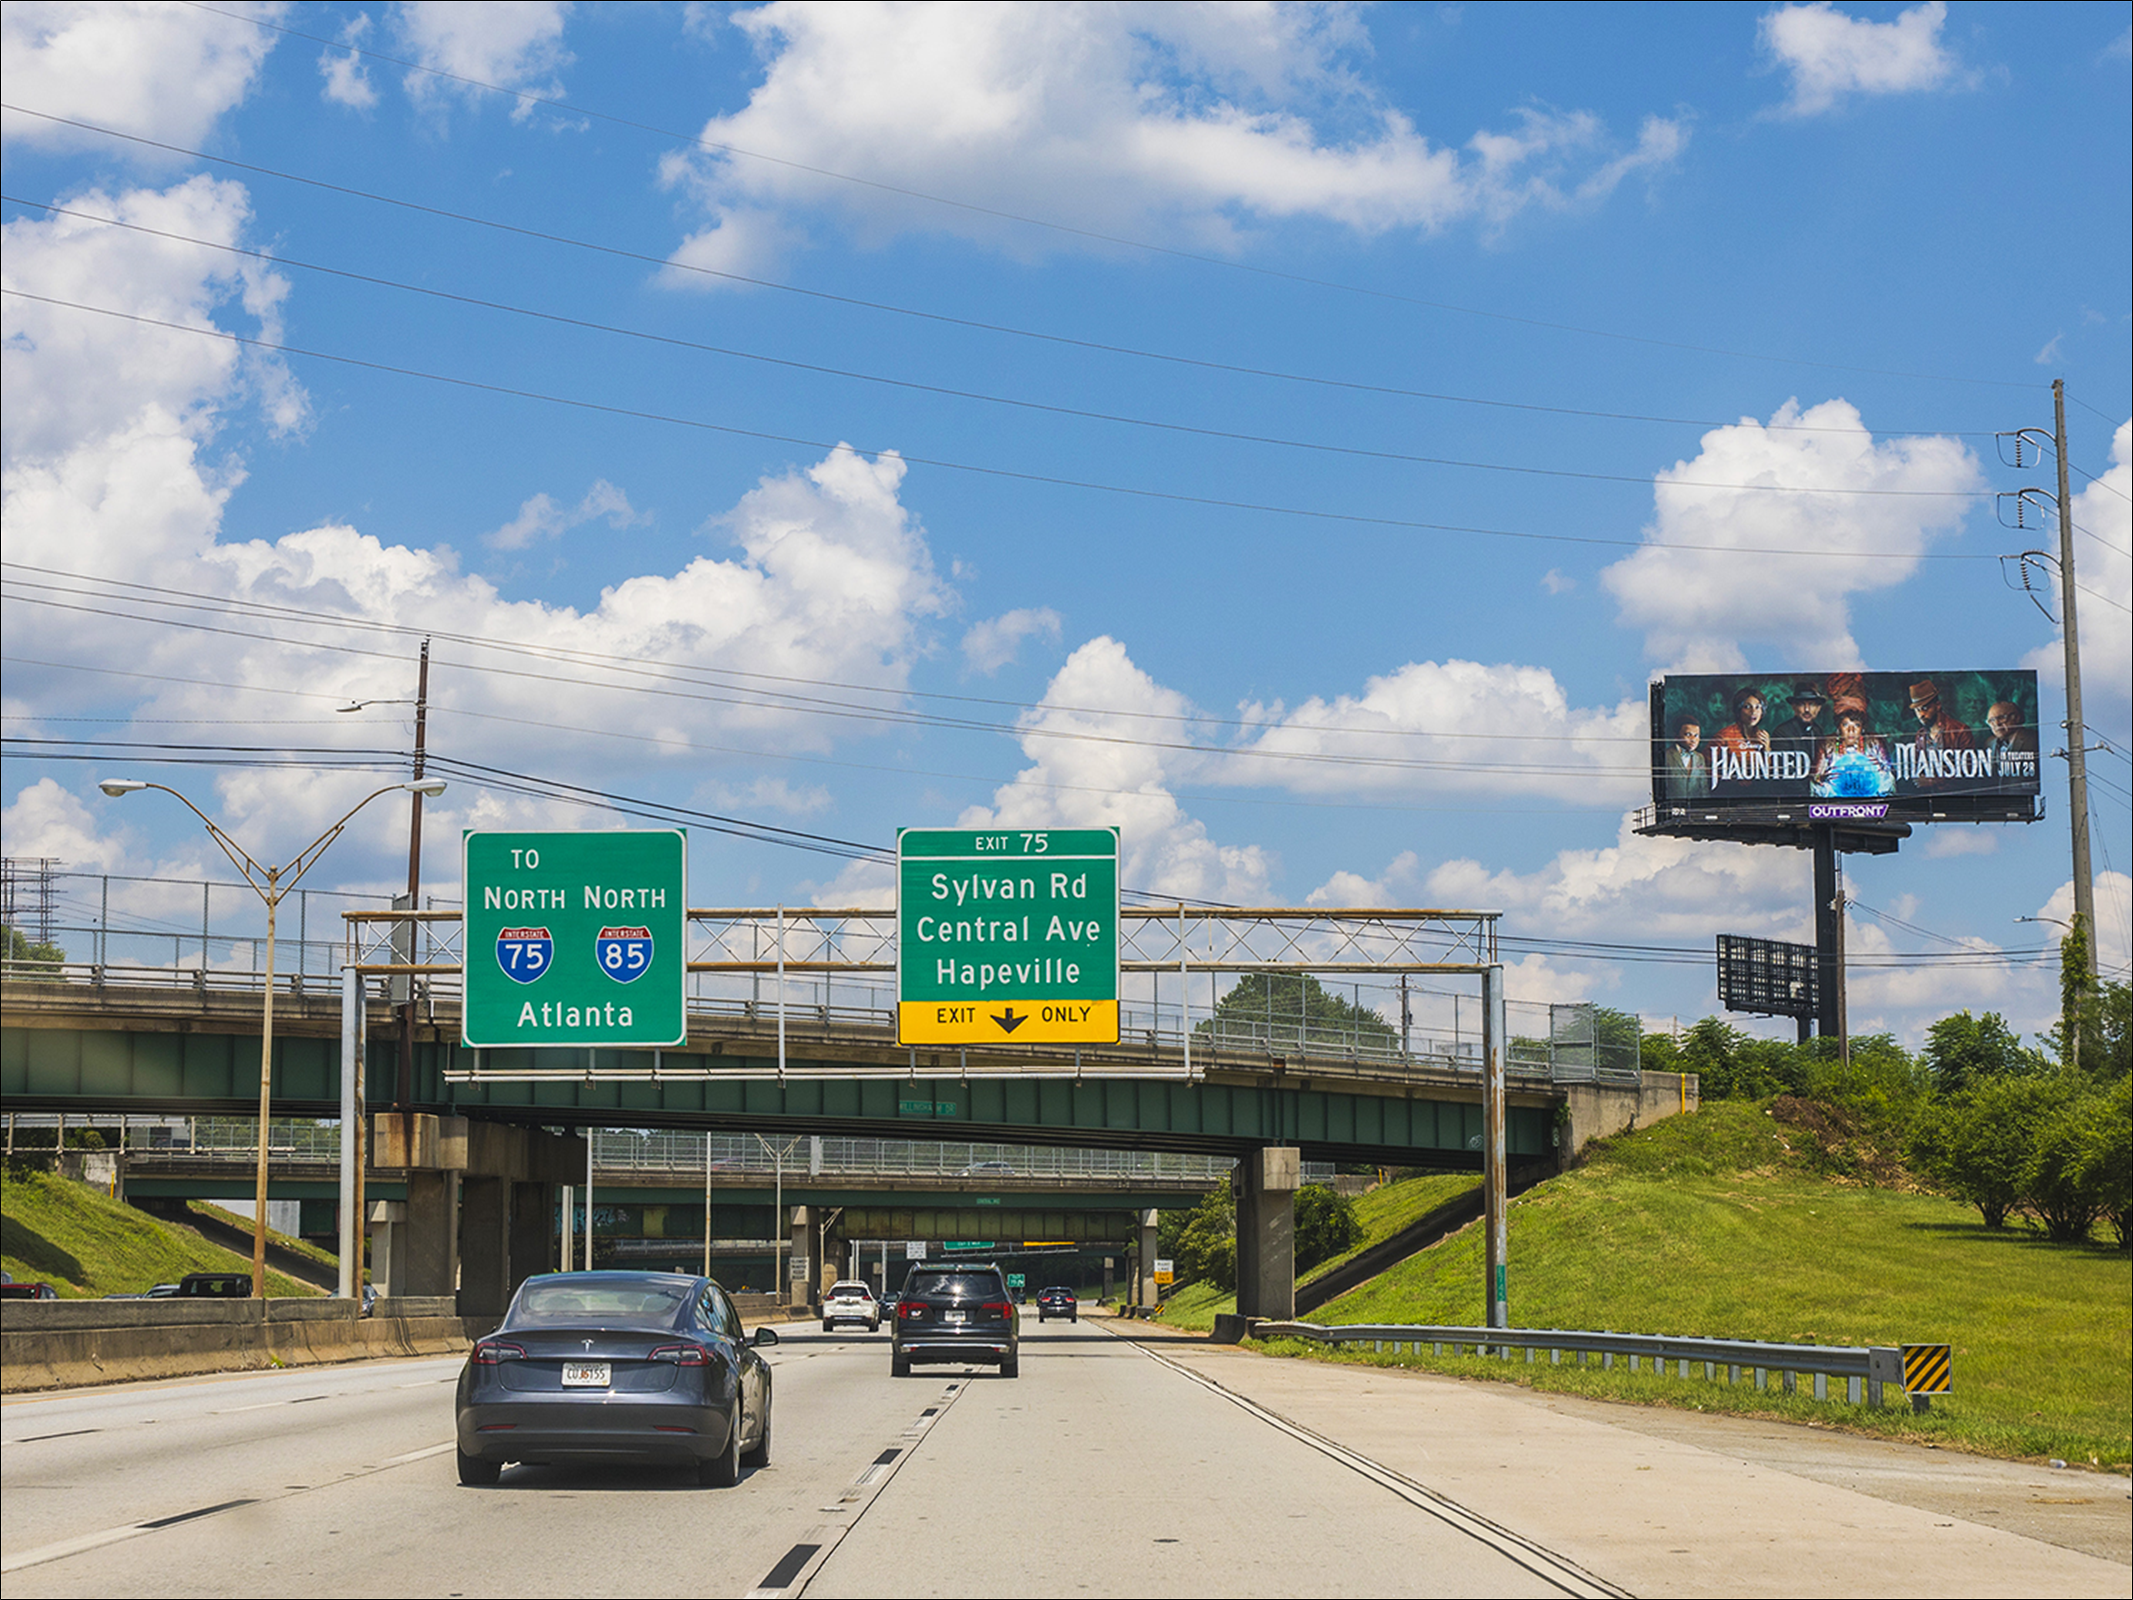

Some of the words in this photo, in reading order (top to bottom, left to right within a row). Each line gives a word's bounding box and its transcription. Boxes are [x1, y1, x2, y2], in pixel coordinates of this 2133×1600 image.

[1710, 746, 1811, 791] HAUNTED
[1895, 743, 1992, 781] MANSION
[1998, 761, 2021, 777] JULY
[2023, 761, 2035, 777] 28
[1812, 806, 1884, 817] OUTFRONT
[976, 837, 1008, 850] EXIT
[1020, 833, 1048, 853] 75
[511, 849, 540, 869] TO
[484, 886, 565, 910] NORTH
[584, 885, 665, 909] NORTH
[932, 873, 1035, 906] Sylvan
[1051, 873, 1086, 898] Rd
[505, 931, 545, 939] INTERSTATE
[604, 930, 645, 938] INTERSTATE
[917, 916, 1029, 942] Central
[1045, 915, 1100, 941] Ave
[505, 944, 544, 969] 75
[605, 943, 645, 969] 85
[937, 958, 1080, 991] Hapeville
[517, 1001, 633, 1027] Atlanta
[937, 1008, 975, 1023] EXIT
[1042, 1007, 1091, 1022] ONLY
